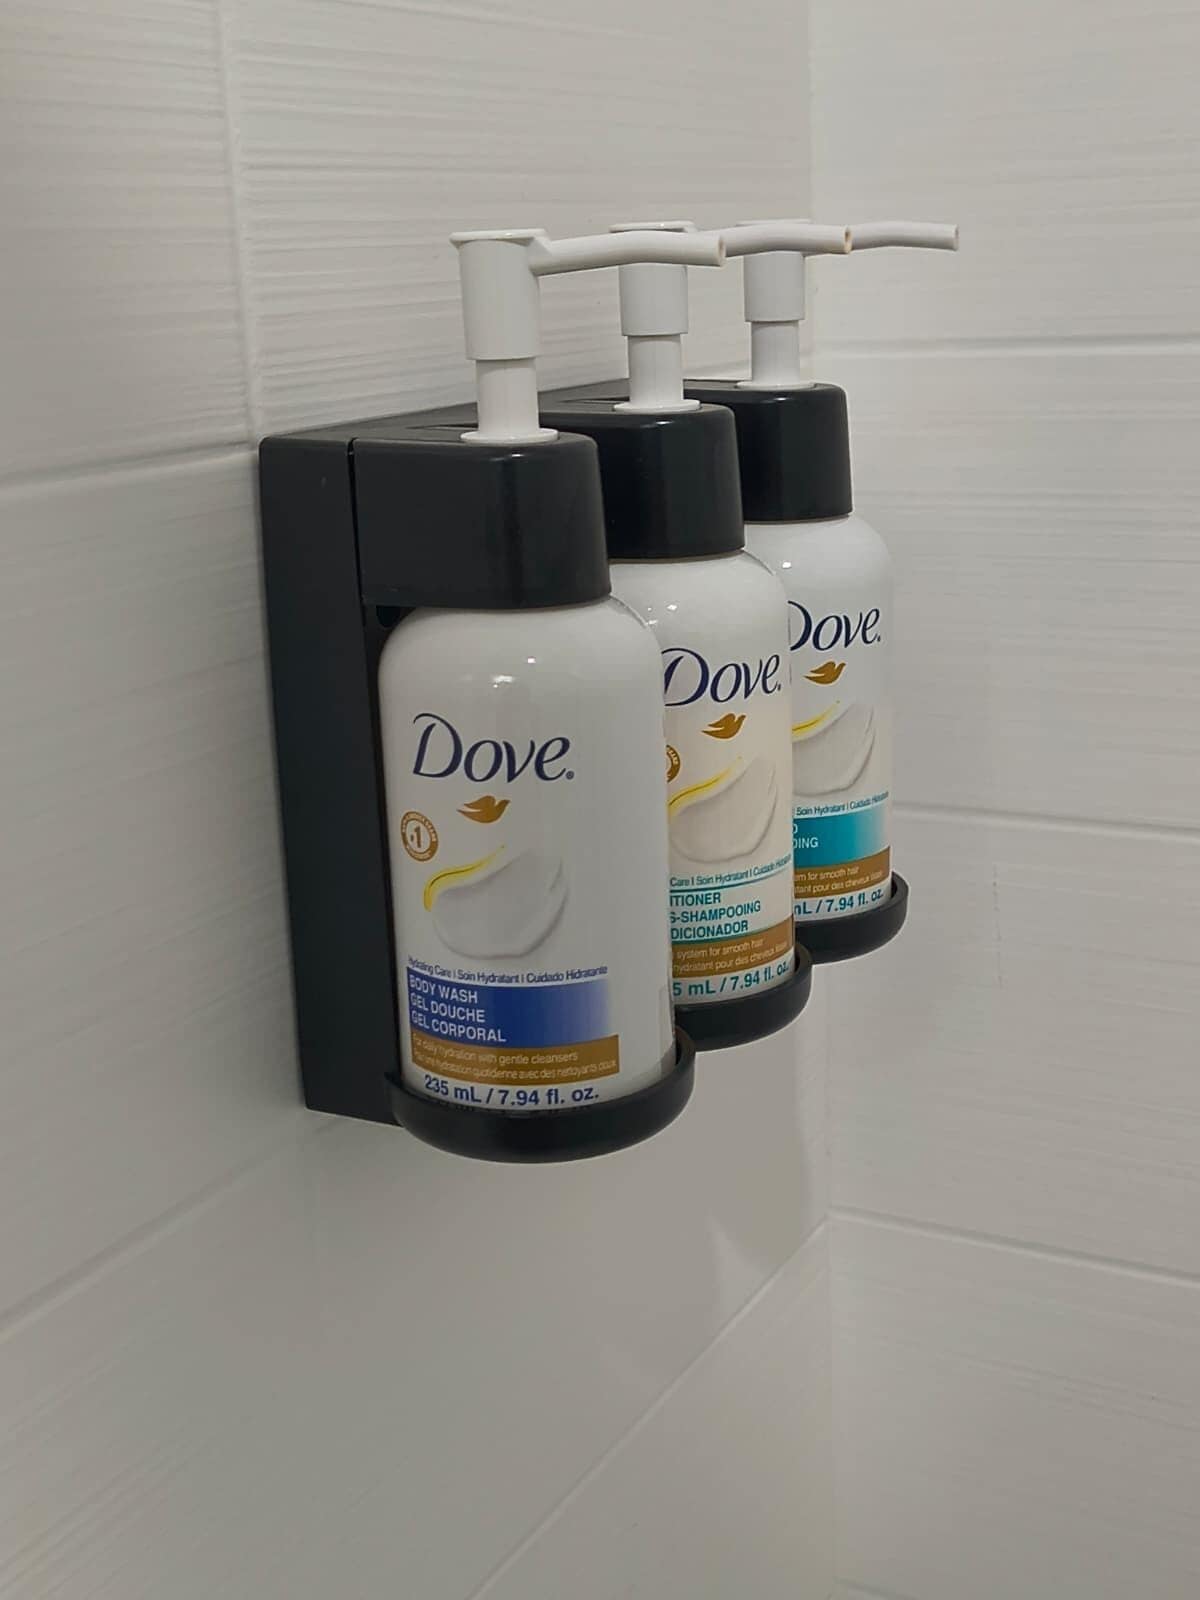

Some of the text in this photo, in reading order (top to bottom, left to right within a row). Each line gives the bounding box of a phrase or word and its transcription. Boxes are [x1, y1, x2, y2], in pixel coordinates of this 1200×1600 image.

[661, 647, 780, 706] Dove
[412, 713, 572, 783] Dove
[796, 805, 813, 816] Soin
[669, 876, 690, 887] Care
[696, 875, 714, 885] Soin
[715, 869, 748, 885] Hydratant
[807, 872, 818, 880] for
[820, 868, 846, 880] smooth
[812, 884, 830, 893] pour
[825, 895, 854, 912] 7.94
[858, 892, 869, 906] fl.
[671, 920, 749, 939] DICIONADOR
[677, 947, 708, 960] system
[708, 945, 720, 956] for
[722, 942, 751, 954] smooth
[715, 959, 734, 971] pour
[735, 955, 749, 966] des
[434, 965, 452, 978] Care
[457, 968, 475, 980] Soin
[477, 971, 519, 984] Hydratant
[526, 972, 564, 983] Cuidado
[566, 966, 608, 980] Hidratante
[688, 980, 716, 995] mL
[730, 971, 760, 991] 7.94
[764, 966, 774, 982] fl.
[409, 974, 478, 1004] BODY WASH
[410, 993, 486, 1023] GEL DOUCHE
[411, 1010, 430, 1029] GEL
[431, 1019, 507, 1042] CORPORAL
[499, 1054, 529, 1066] gentle
[531, 1052, 578, 1064] cleansers
[425, 1074, 449, 1095] 235
[454, 1086, 482, 1103] mL
[498, 1089, 540, 1106] 7.94
[546, 1088, 565, 1104] fl.
[571, 1087, 599, 1102] oz.
